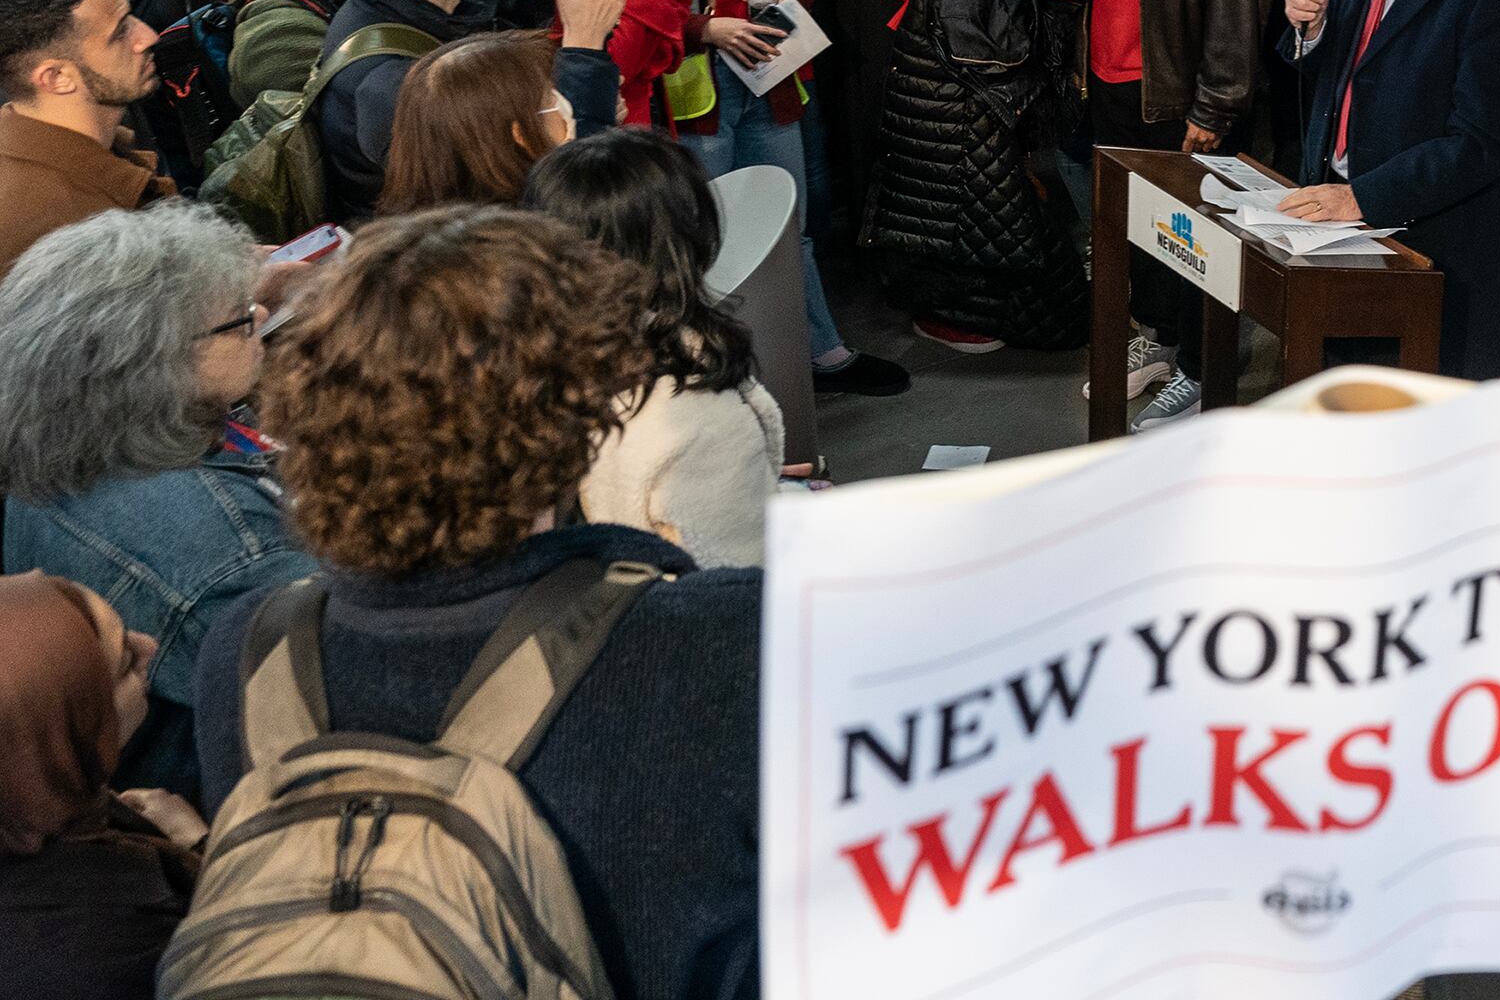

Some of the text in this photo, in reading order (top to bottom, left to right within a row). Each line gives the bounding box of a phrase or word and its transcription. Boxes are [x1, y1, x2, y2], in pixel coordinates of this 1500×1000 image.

[1157, 231, 1207, 275] NEWSGUILD
[838, 638, 1108, 803] NEW
[1131, 592, 1428, 690] YORK
[839, 722, 1396, 933] WALKS
